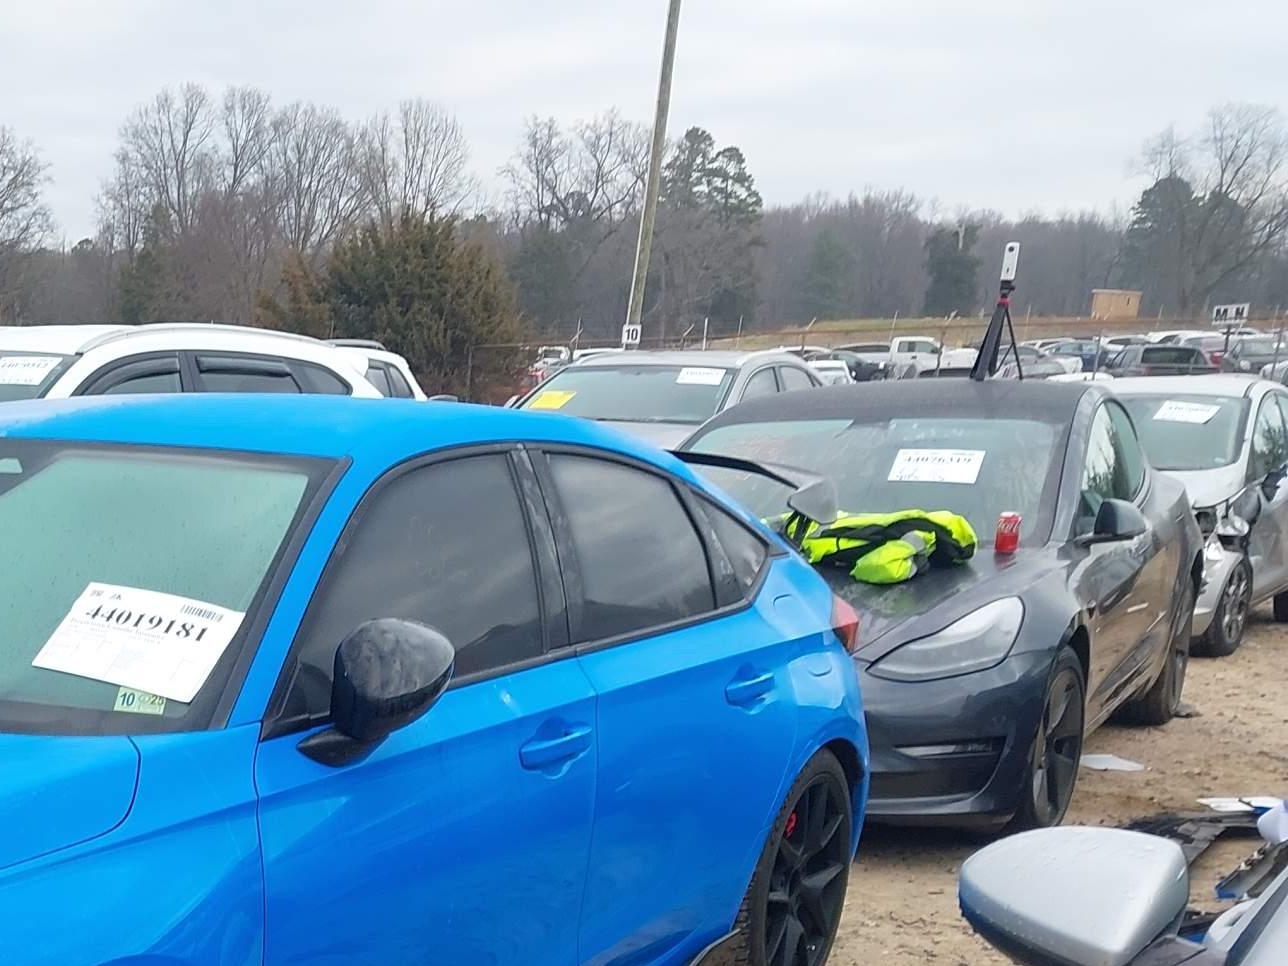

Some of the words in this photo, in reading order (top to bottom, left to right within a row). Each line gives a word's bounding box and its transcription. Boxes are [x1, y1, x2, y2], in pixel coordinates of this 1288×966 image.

[625, 328, 639, 341] 10
[85, 604, 209, 642] 44019181
[120, 692, 136, 706] 10
